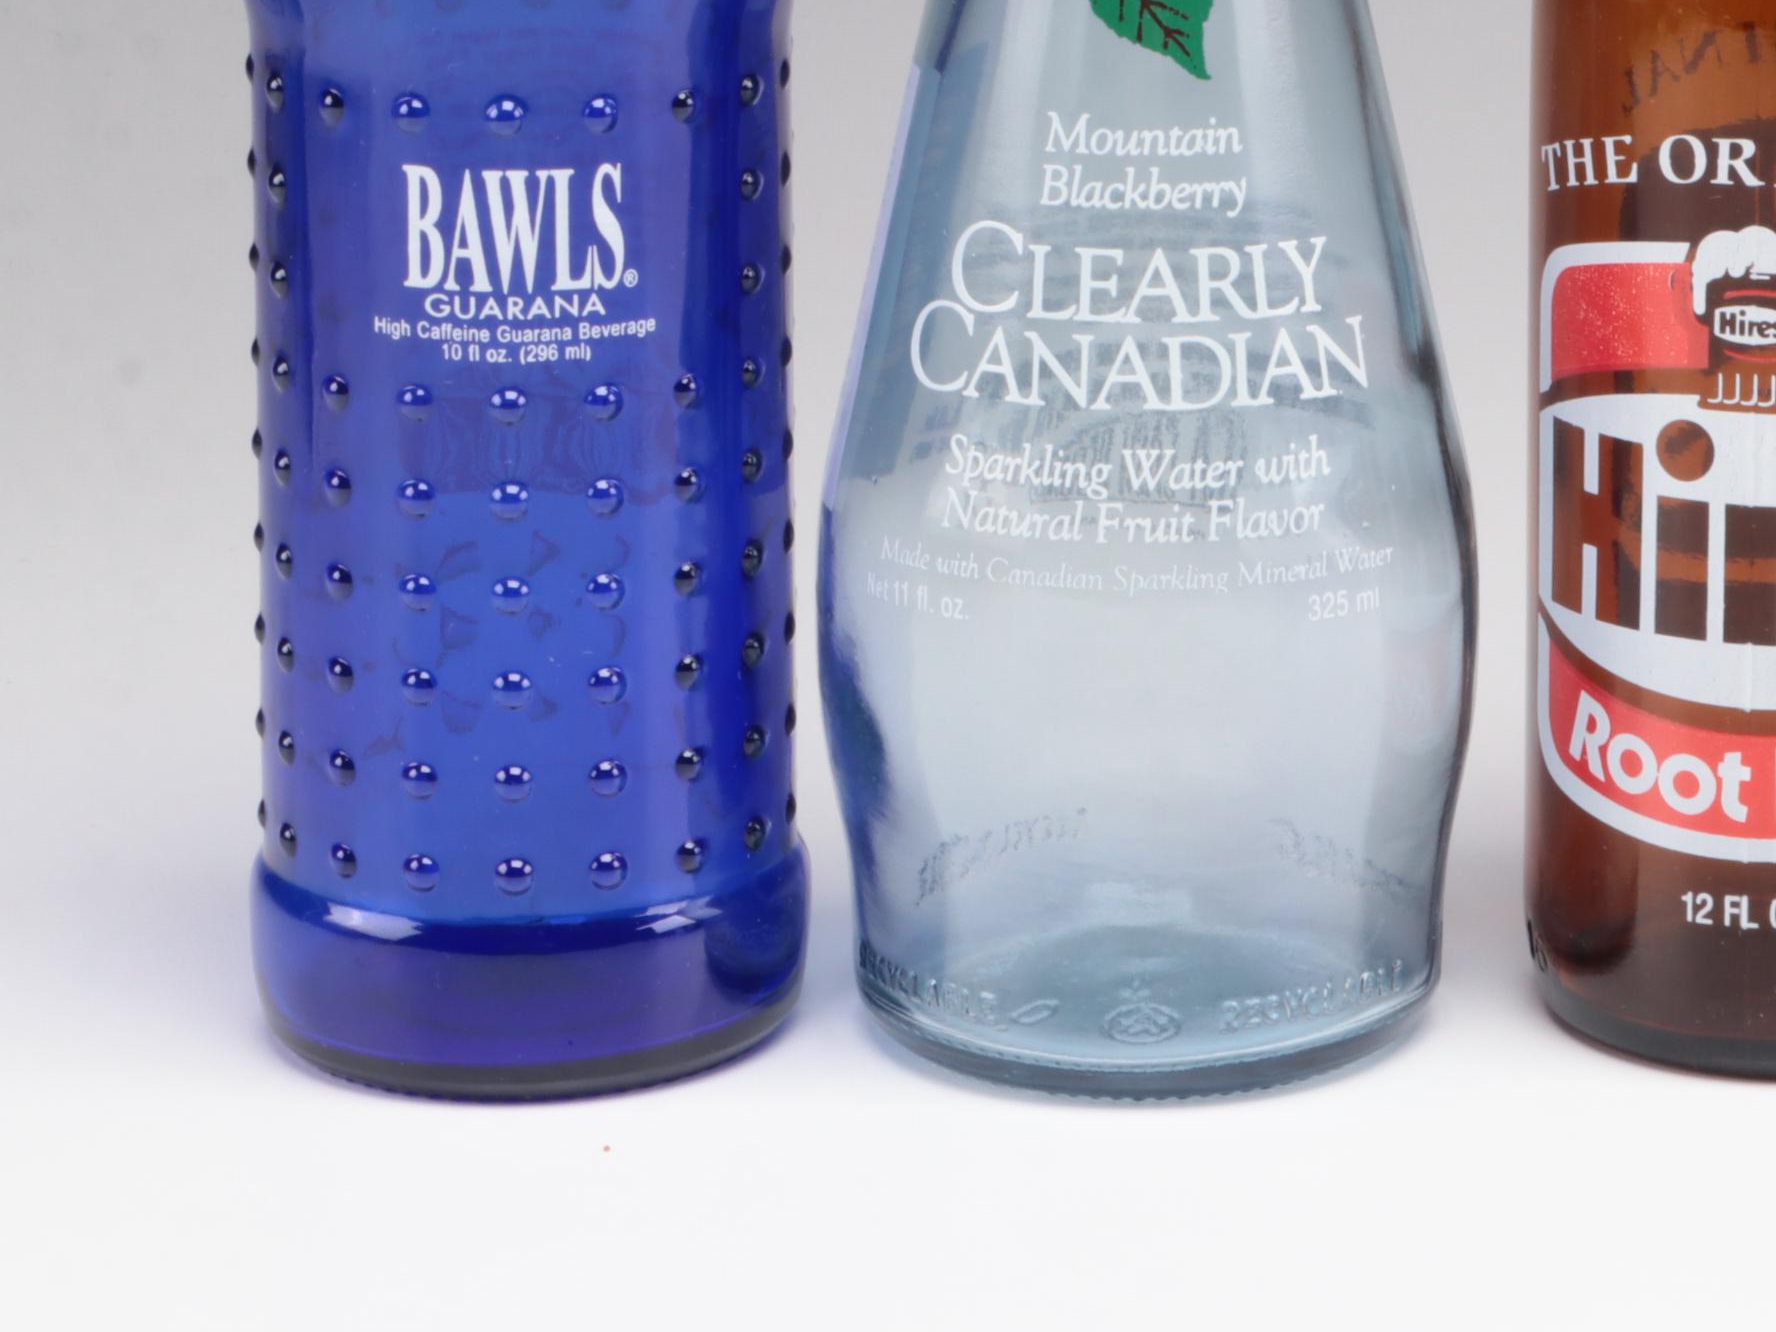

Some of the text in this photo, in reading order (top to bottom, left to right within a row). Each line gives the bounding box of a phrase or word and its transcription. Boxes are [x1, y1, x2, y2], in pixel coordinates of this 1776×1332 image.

[1045, 112, 1243, 155] Mountain
[1541, 135, 1638, 192] THE
[1040, 165, 1247, 217] Blackberry
[952, 220, 1327, 324] CLEARLY
[375, 316, 656, 342] High Caffeine Guarana Beverage
[425, 293, 606, 320] GUARANA
[441, 344, 462, 361] 10
[486, 349, 513, 363] oz.
[519, 344, 558, 364] (296
[565, 343, 591, 363] ml)
[910, 299, 1369, 410] CANADIAN
[945, 435, 1331, 499] Sparkling Water with
[941, 487, 1324, 545] Natural Fruit Flavor
[880, 536, 1394, 596] Made with Canadian Sparkling Mineral Water
[866, 571, 970, 619] Net 11 fl. oz.
[1308, 586, 1380, 621] 325 ml
[1569, 691, 1752, 824] Root
[1681, 891, 1713, 925] 12
[1725, 895, 1758, 930] FL
